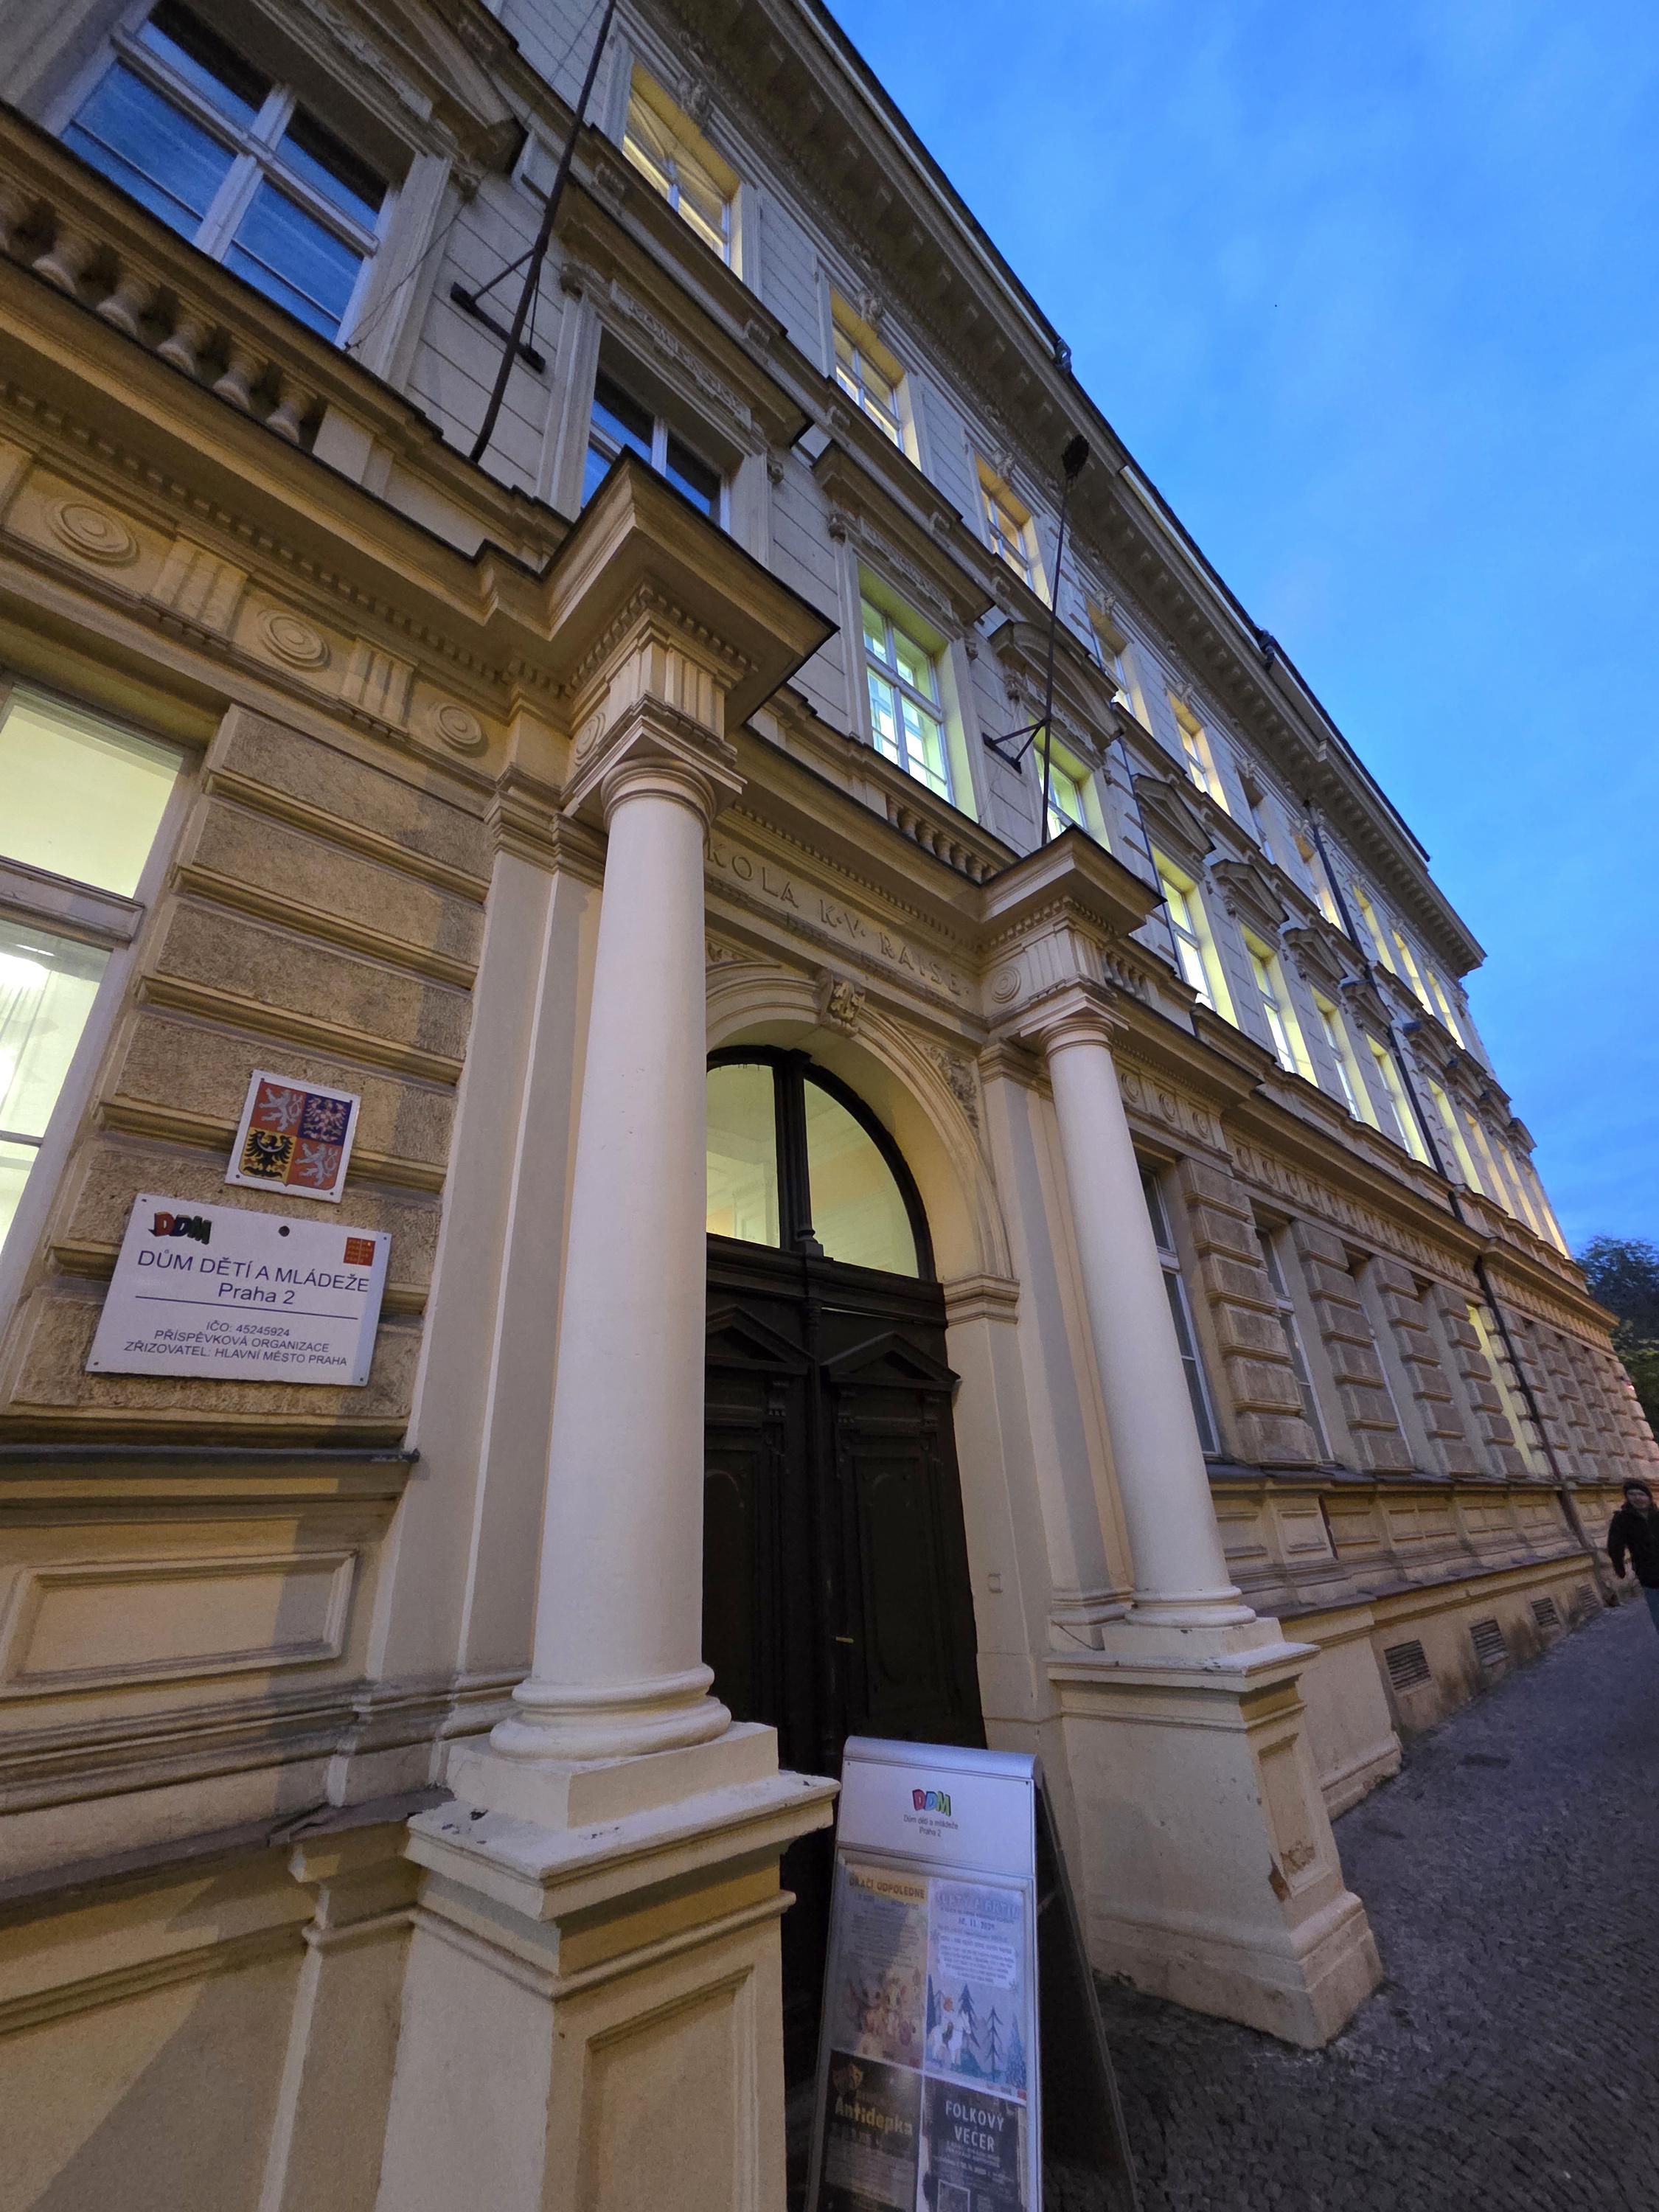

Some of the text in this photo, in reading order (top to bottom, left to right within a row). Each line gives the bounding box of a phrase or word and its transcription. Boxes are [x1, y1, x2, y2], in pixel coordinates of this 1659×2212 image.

[706, 838, 799, 908] KOLA
[153, 1211, 212, 1245] DDM
[137, 1249, 370, 1293] DŮM DĚTÍ A MLÁDEŽE
[218, 1282, 295, 1305] Praha 2
[154, 1329, 330, 1353] PŘÍSPĚVKOVÁ ORGANIZACE
[235, 1324, 290, 1337] 45245924
[215, 1348, 261, 1360] HLAVNÍ
[262, 1350, 305, 1363] MĚSTO
[308, 1354, 348, 1366] PRAHA
[912, 1789, 951, 1817] DDM
[876, 1881, 925, 1899] ODPOLEDNE
[945, 2099, 1004, 2132] FOLKOVÝ
[954, 2125, 995, 2152] VEČER
